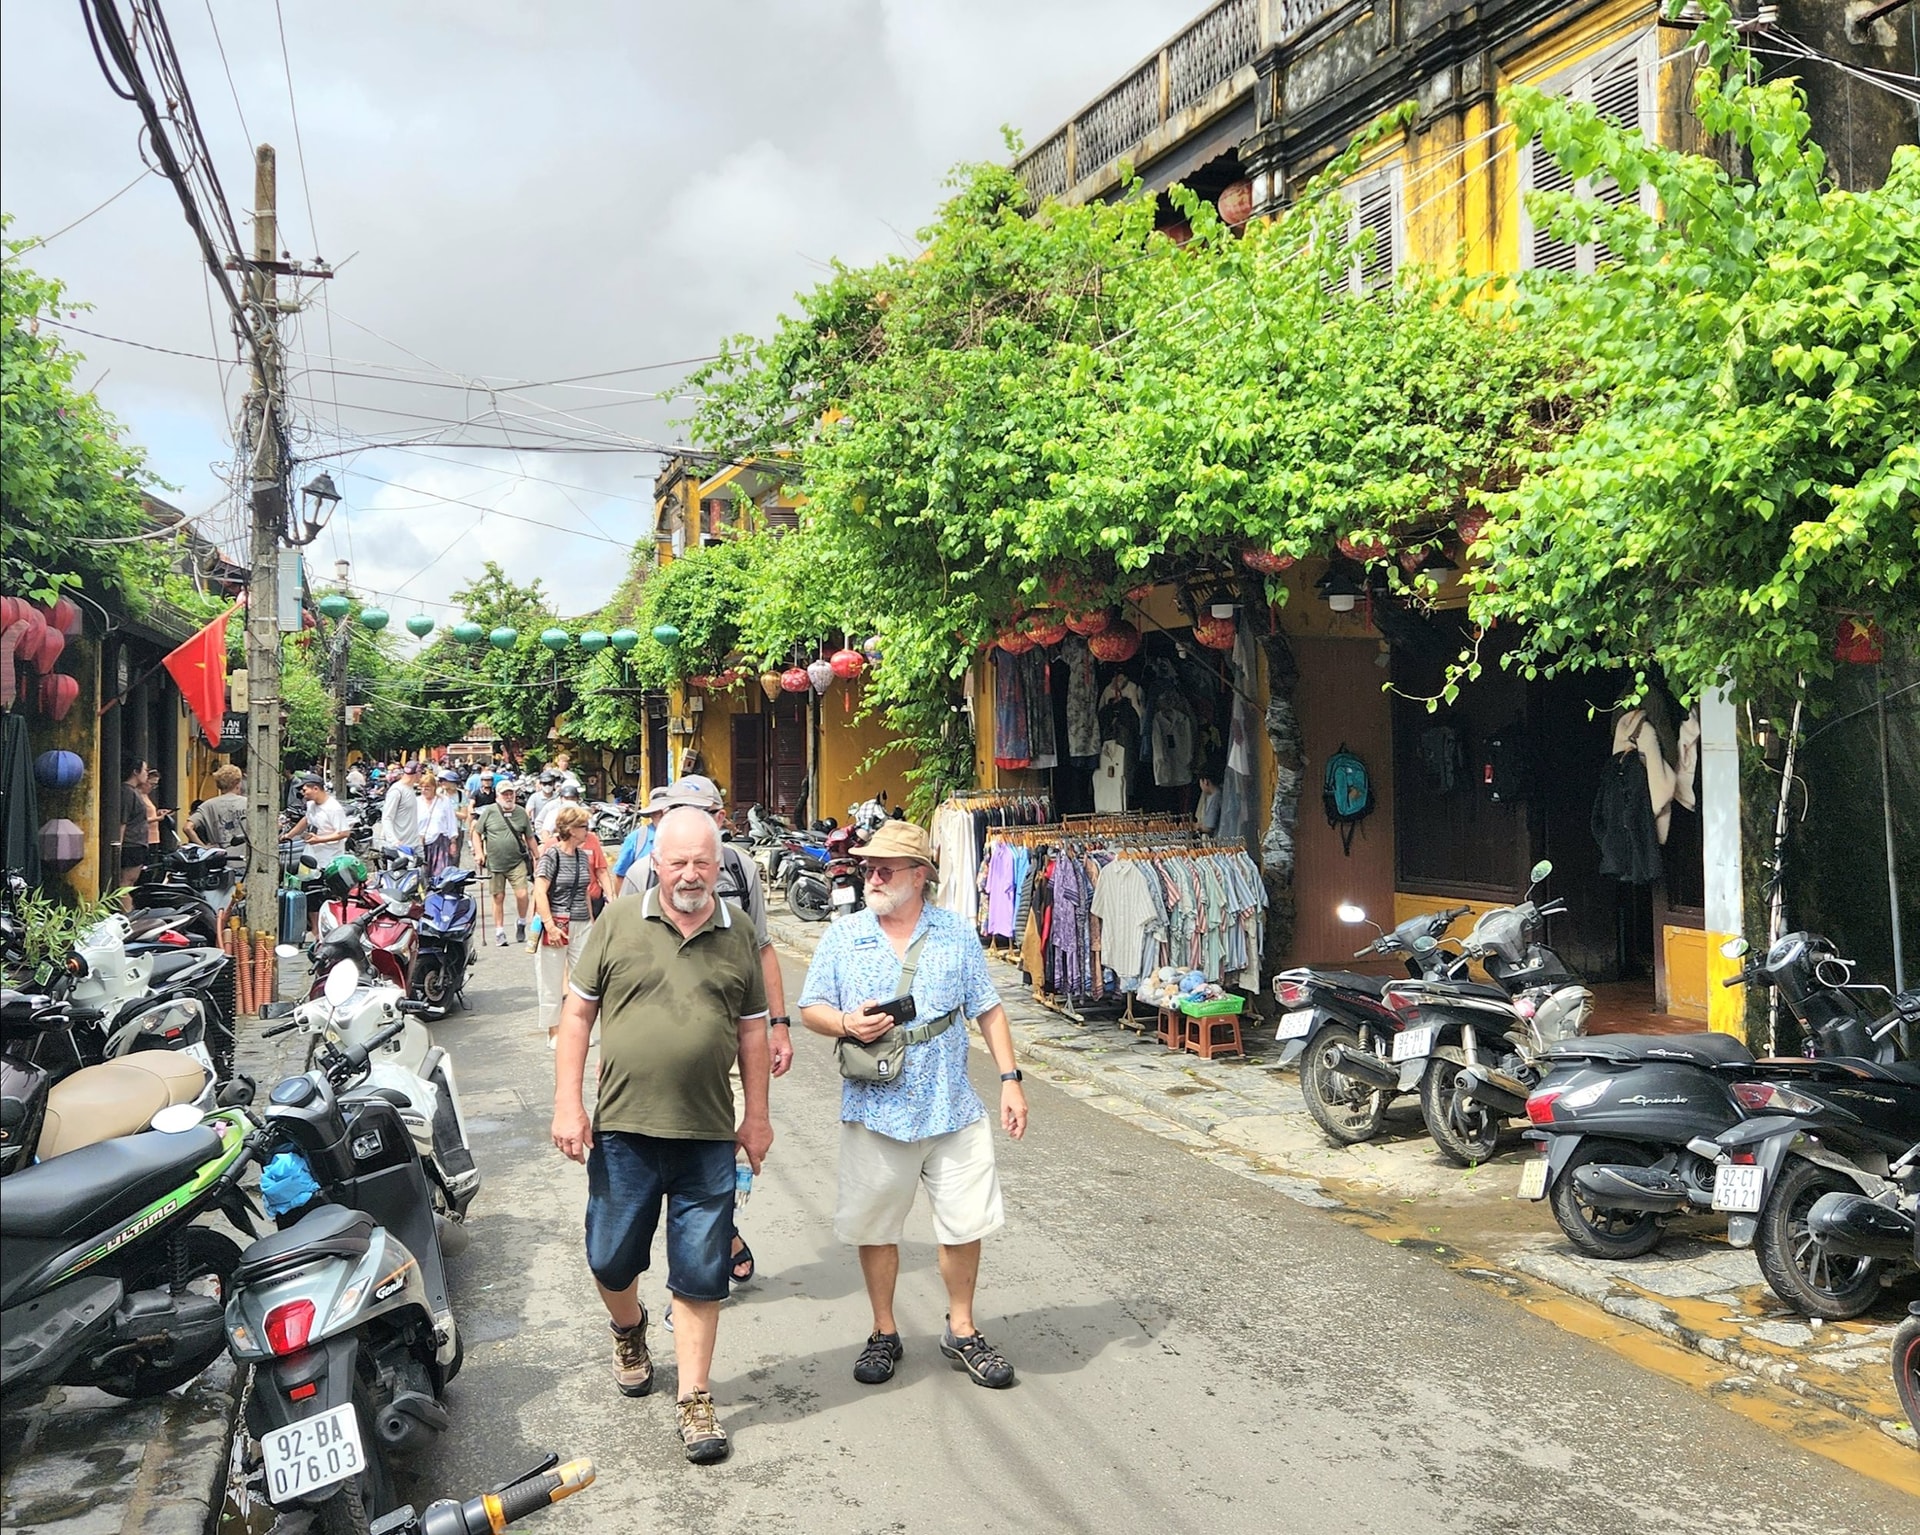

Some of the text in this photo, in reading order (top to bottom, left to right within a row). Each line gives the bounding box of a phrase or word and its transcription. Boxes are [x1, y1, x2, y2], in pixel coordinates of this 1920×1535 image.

[1618, 1094, 1688, 1107] Grande
[1722, 1169, 1754, 1188] 92-C1
[277, 1414, 344, 1462] 92-BA
[274, 1441, 358, 1495] 076.03
